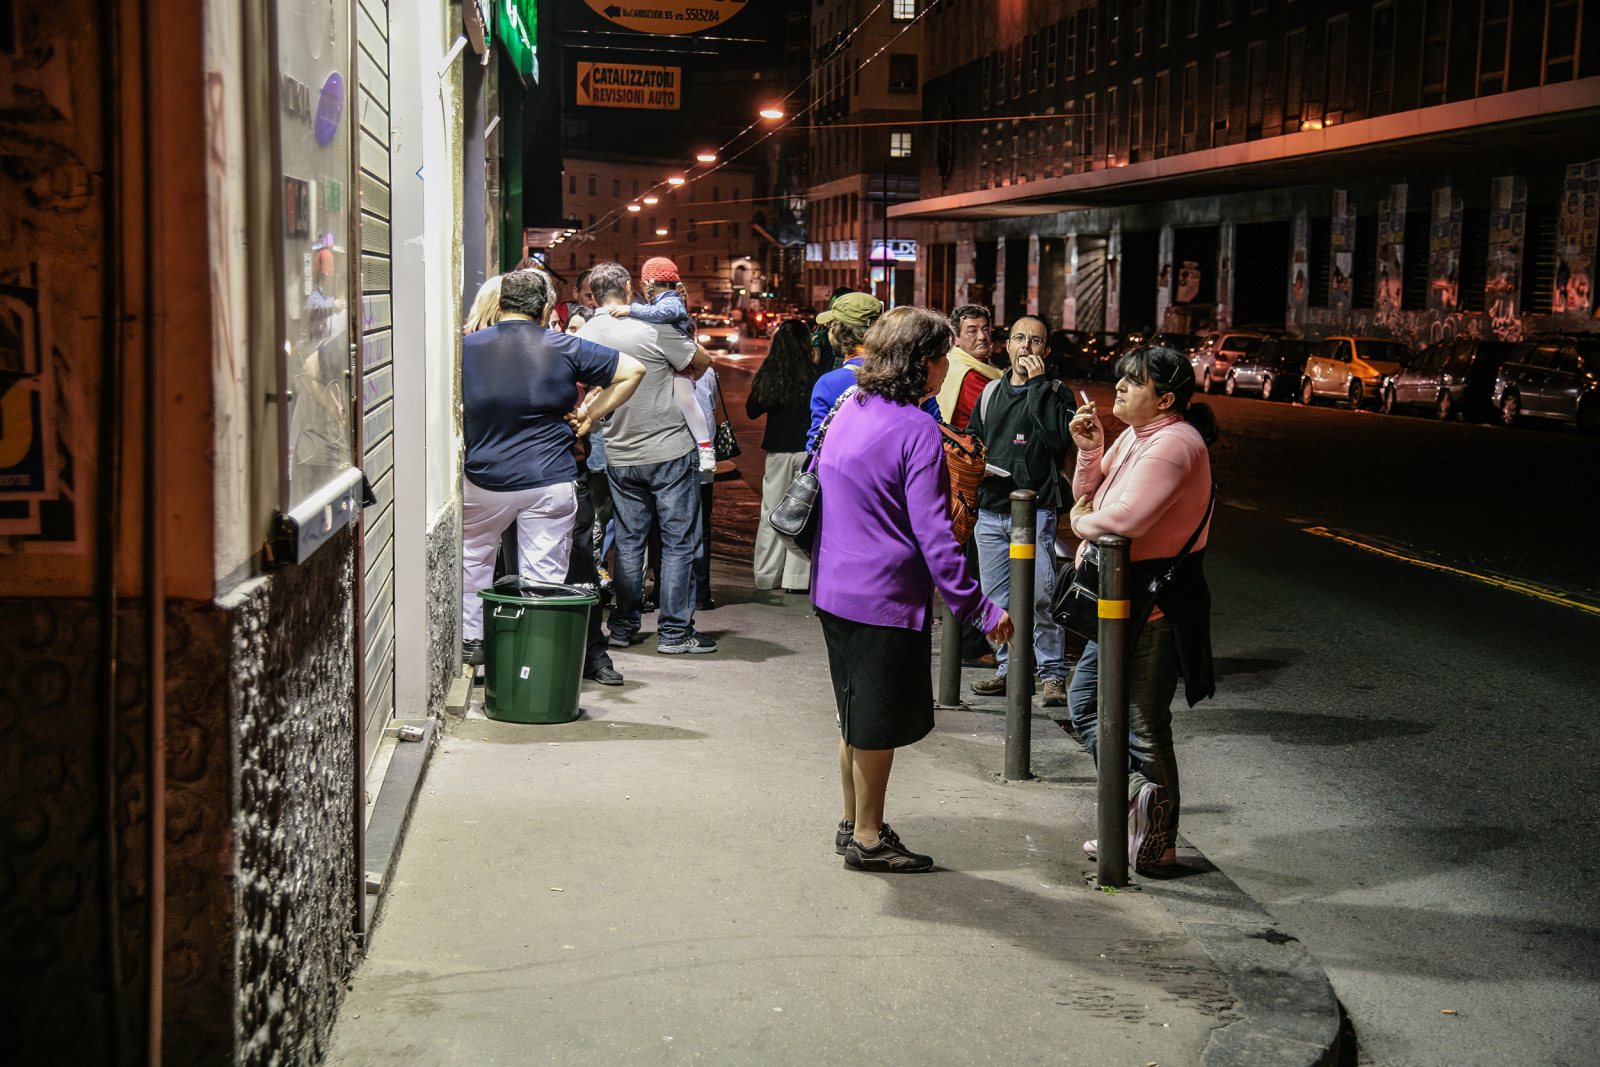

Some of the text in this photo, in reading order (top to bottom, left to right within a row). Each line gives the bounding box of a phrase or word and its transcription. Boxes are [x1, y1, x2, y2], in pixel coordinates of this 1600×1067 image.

[593, 67, 674, 88] CATALIZZATORI
[593, 87, 675, 106] REVISIONI AUTO
